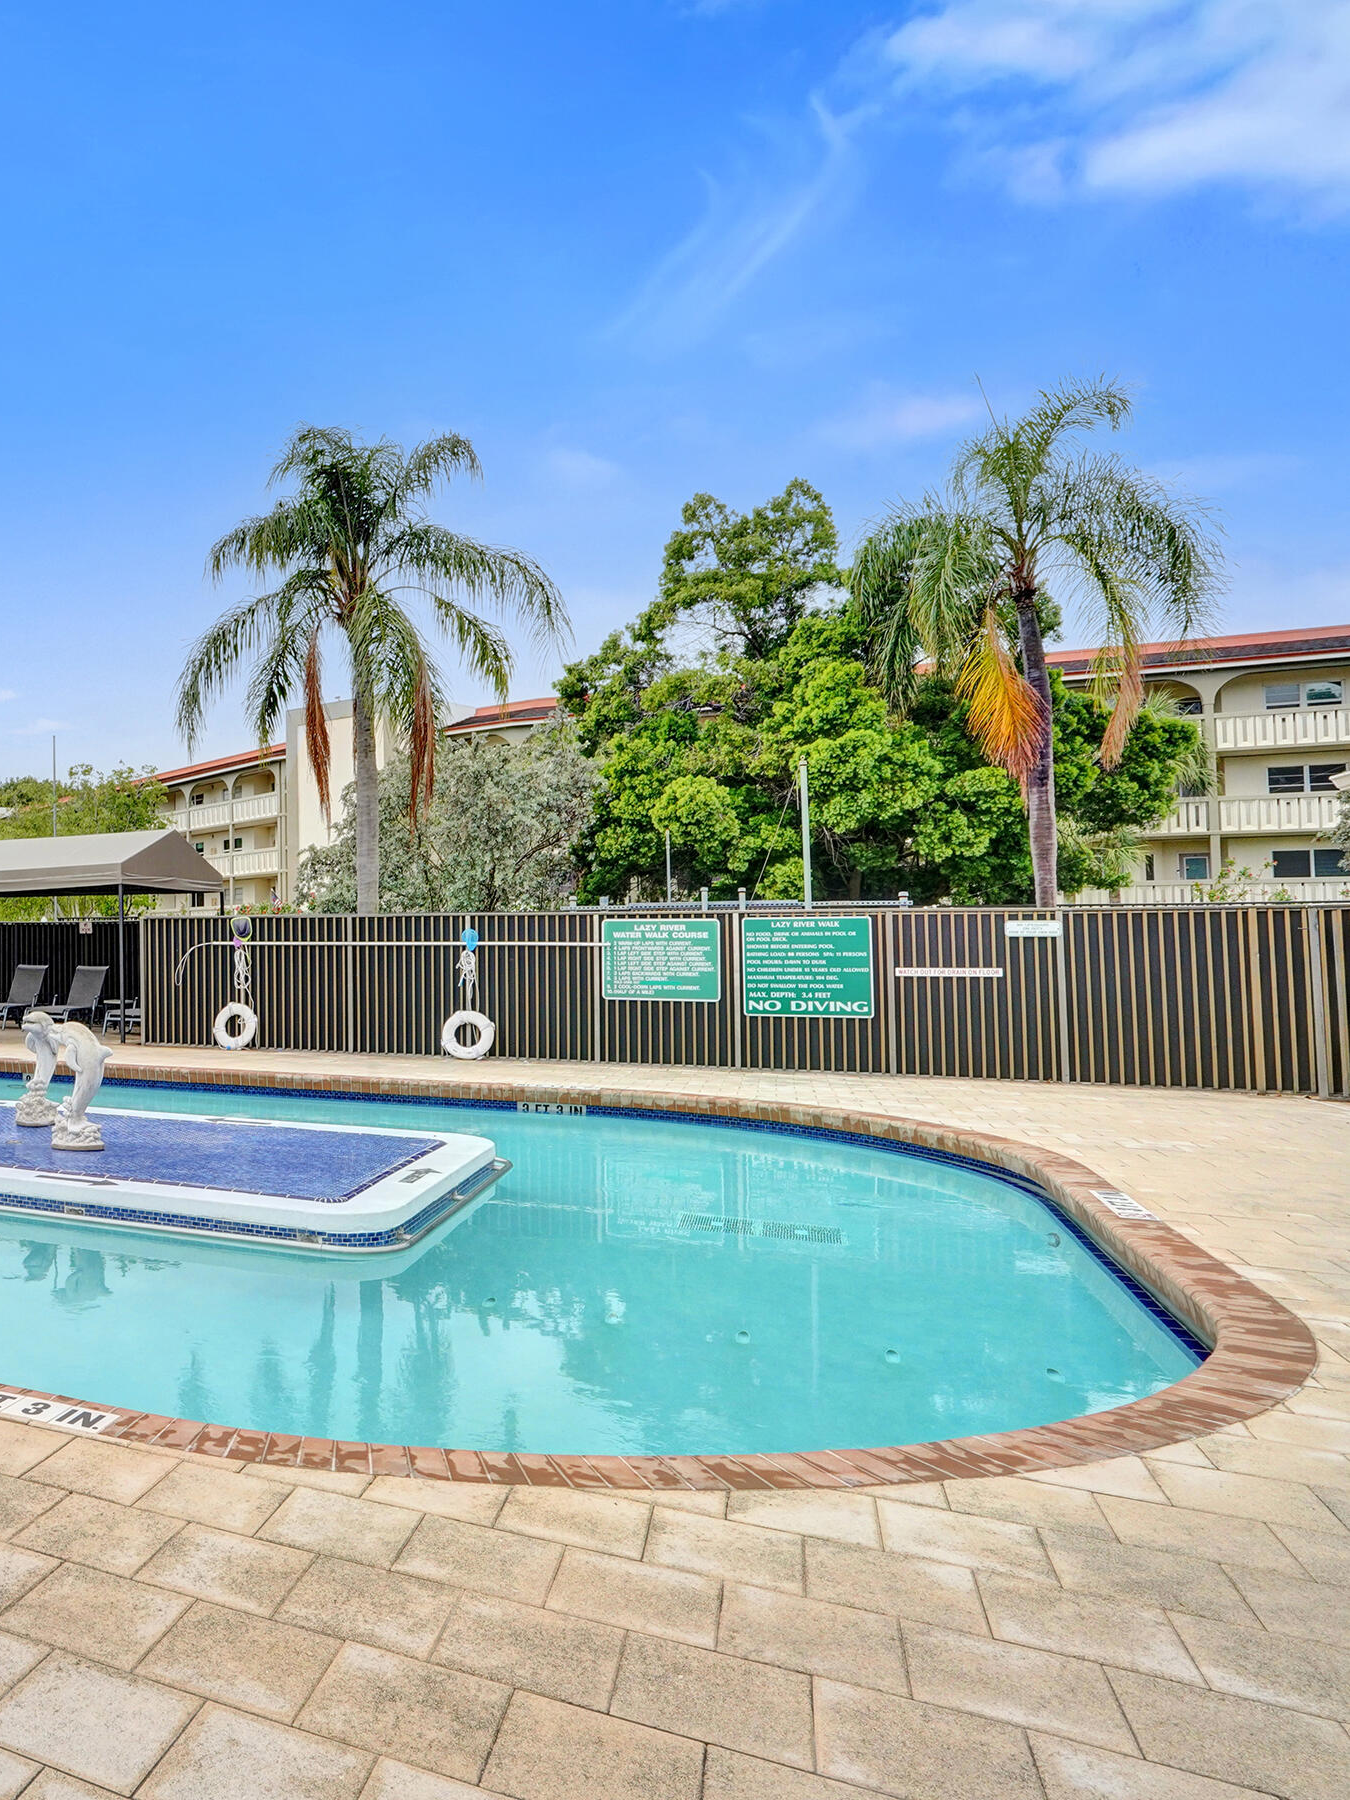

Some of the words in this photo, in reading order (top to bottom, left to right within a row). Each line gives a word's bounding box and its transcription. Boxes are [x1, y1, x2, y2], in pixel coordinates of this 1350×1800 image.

[749, 1001, 781, 1011] NO
[791, 1001, 868, 1012] DIVING
[569, 1106, 583, 1116] IN
[21, 1402, 51, 1415] 3
[54, 1409, 106, 1430] IN.
